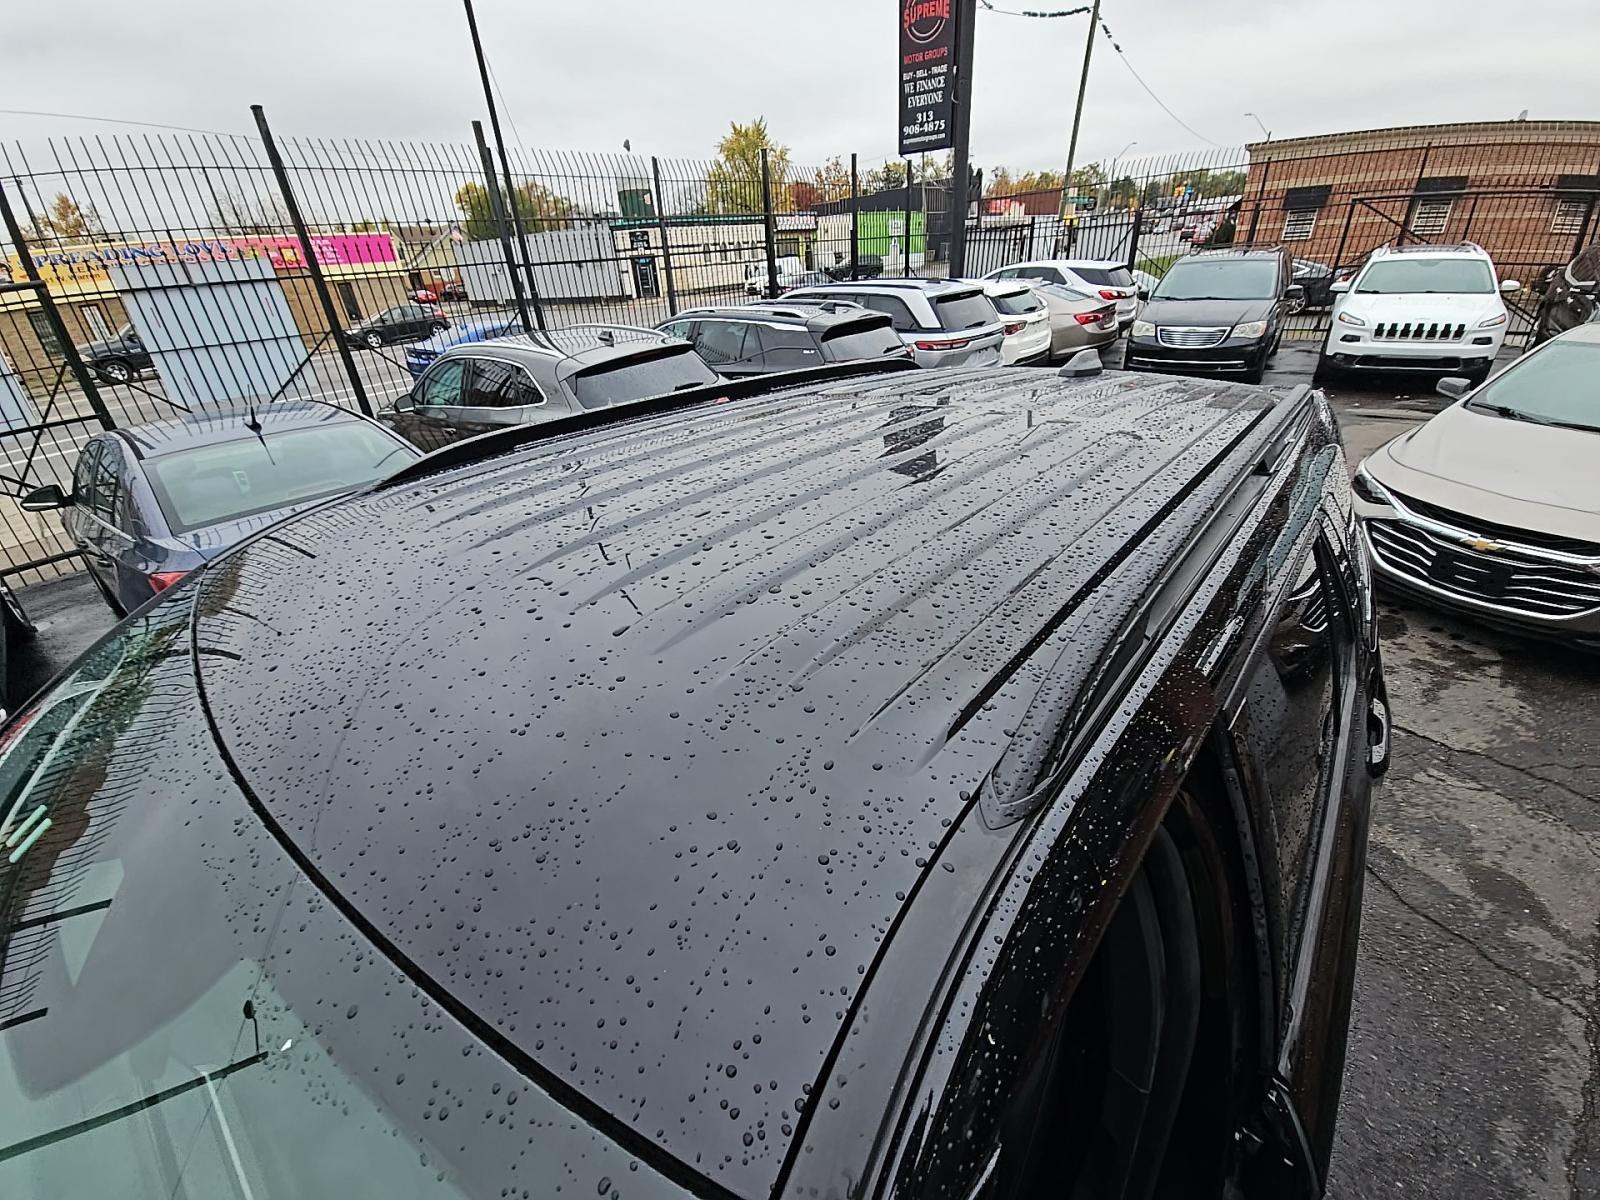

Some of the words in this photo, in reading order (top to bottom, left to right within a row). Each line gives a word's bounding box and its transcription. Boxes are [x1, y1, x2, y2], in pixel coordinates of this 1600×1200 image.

[904, 0, 950, 32] SUPREME
[904, 52, 924, 65] MOTOR
[925, 47, 948, 60] GROUPS
[903, 72, 914, 80] BUY
[916, 69, 928, 78] SELL
[931, 64, 948, 74] TRADE
[904, 82, 915, 94] WE
[916, 76, 946, 93] FINANCE
[907, 90, 944, 108] EVERYONE
[916, 110, 934, 123] 313
[903, 119, 946, 136] 908-4875
